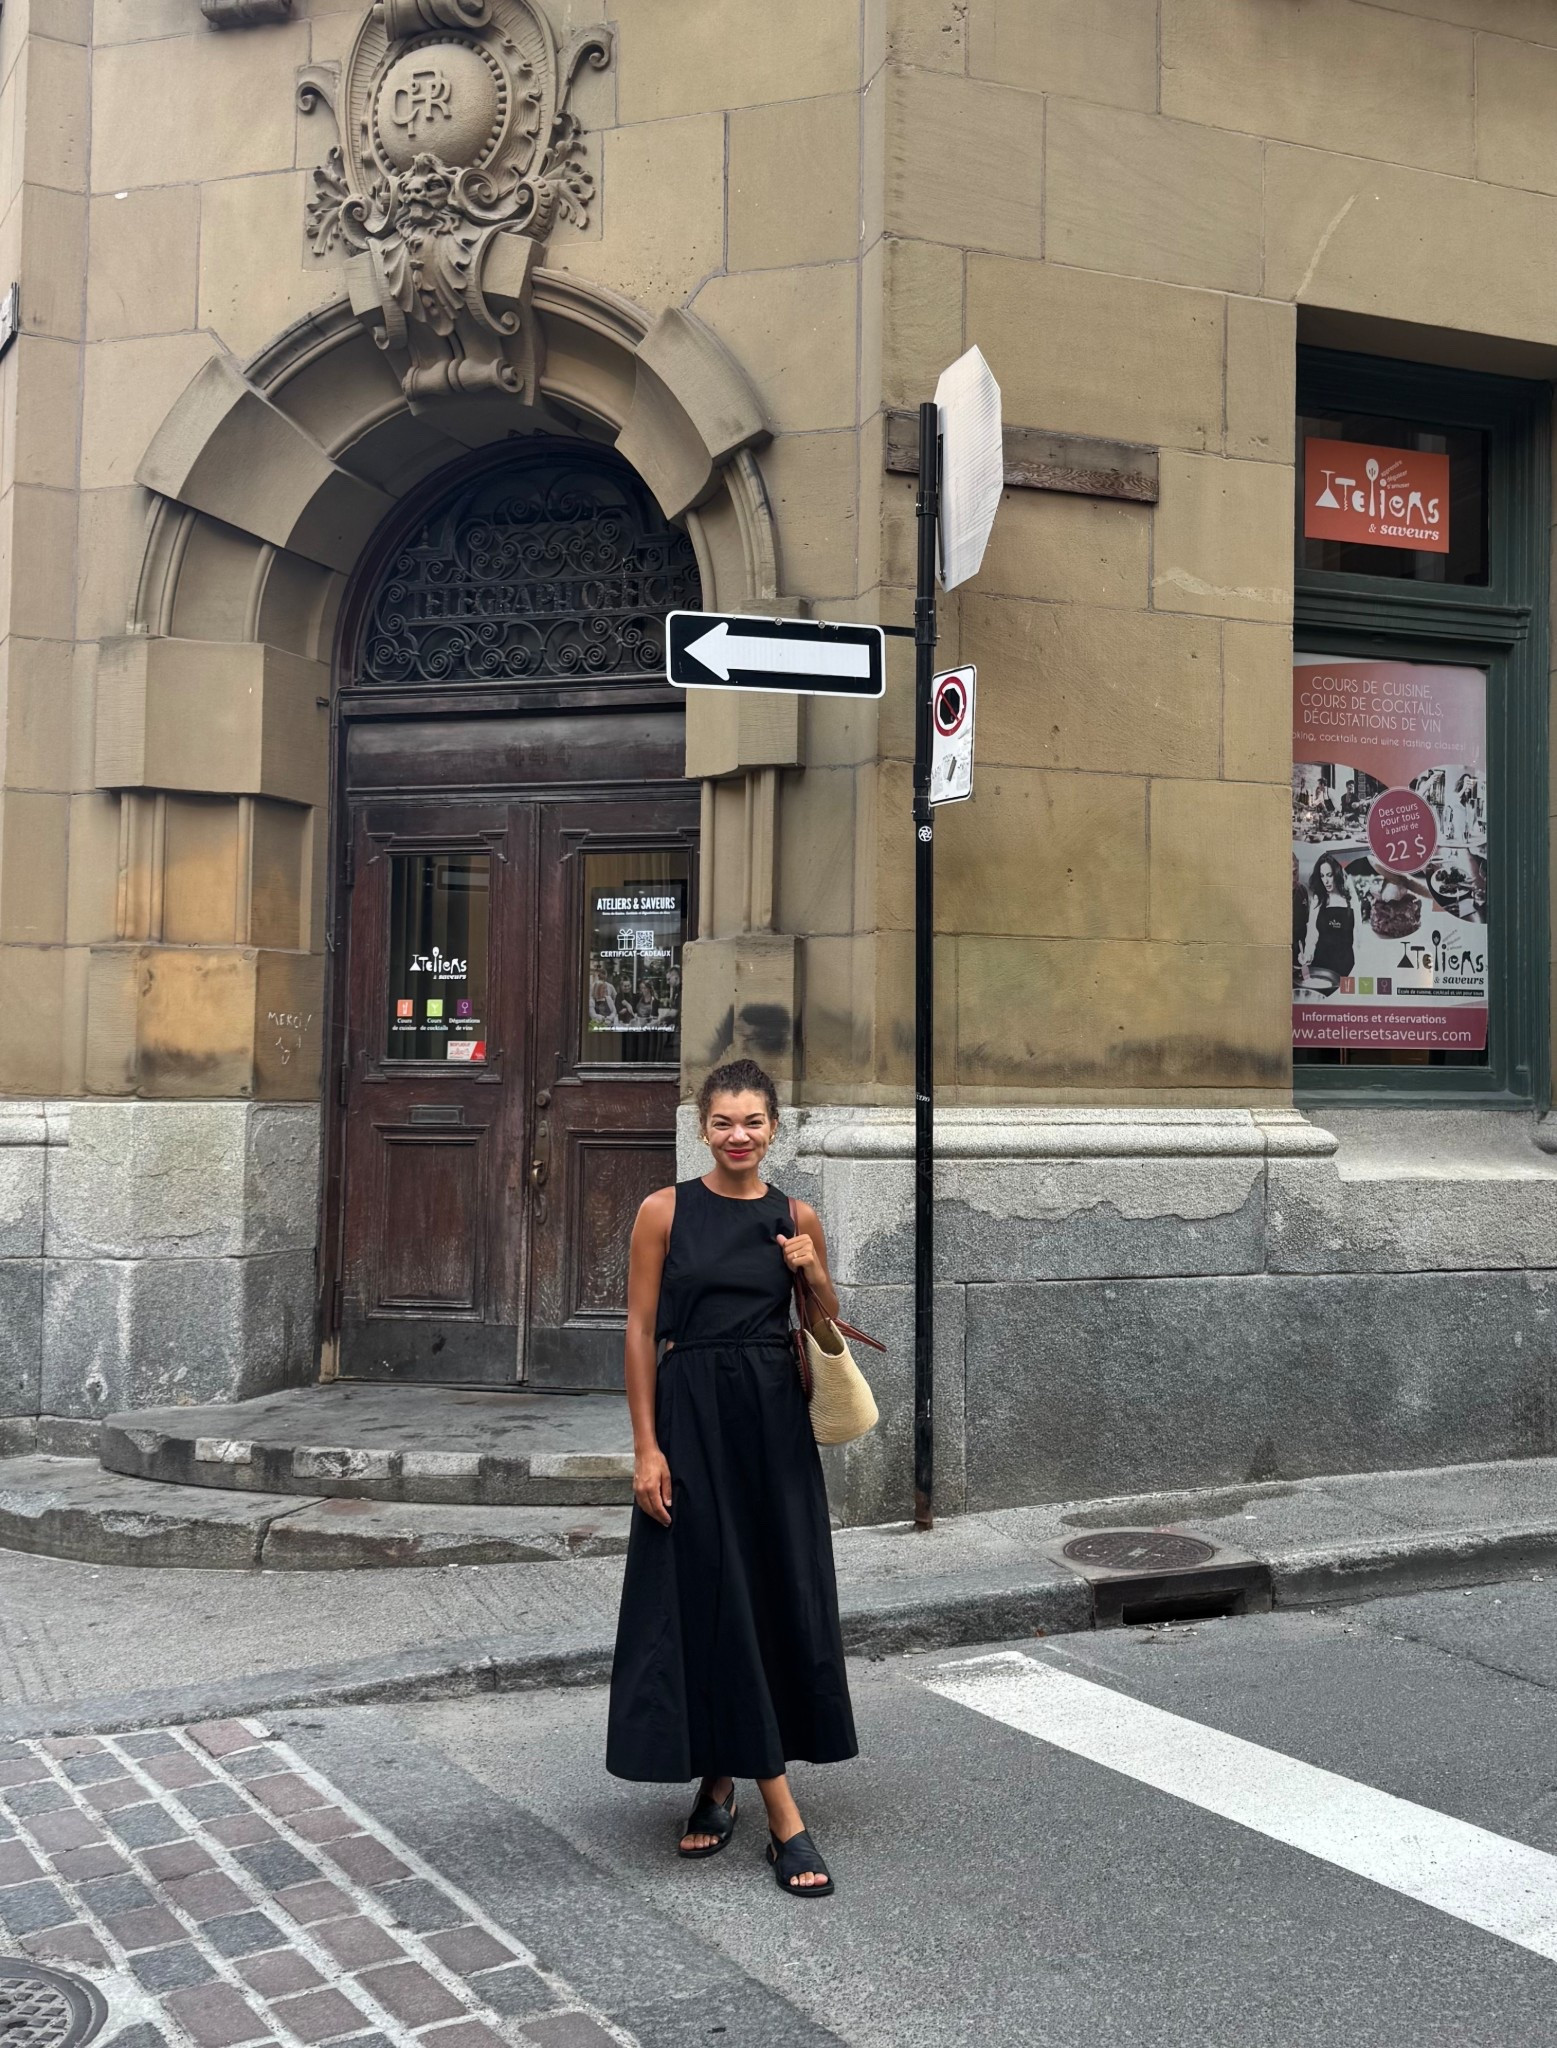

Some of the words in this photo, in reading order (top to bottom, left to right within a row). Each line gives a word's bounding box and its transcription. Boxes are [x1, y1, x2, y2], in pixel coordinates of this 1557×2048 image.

[1368, 523, 1377, 533] &
[1380, 524, 1440, 541] saveurs
[1312, 676, 1359, 693] COURS
[1362, 680, 1378, 695] DE
[1382, 681, 1434, 700] CUISINE,
[1300, 692, 1347, 709] COURS
[1351, 697, 1367, 711] DE
[1371, 698, 1445, 718] COCKTAILS,
[1303, 708, 1397, 730] DÉGUSTATIONS
[1401, 717, 1417, 732] DE
[1421, 719, 1442, 733] VIN
[1319, 733, 1358, 744] cocktails
[1360, 734, 1378, 745] and
[1380, 736, 1400, 747] wine
[1402, 739, 1432, 750] tasting
[1378, 808, 1394, 818] Des
[1395, 803, 1418, 814] cours
[1380, 816, 1400, 828] pour
[1401, 812, 1420, 822] tous
[1391, 824, 1409, 835] partir
[1409, 822, 1419, 830] de
[1385, 840, 1410, 862] 22
[1414, 834, 1426, 858] $
[596, 897, 632, 910] ATELIERS
[633, 897, 640, 910] &
[641, 896, 676, 910] SAVEURS
[600, 950, 671, 958] CERTIFICAT-CADEAUX
[1442, 976, 1485, 985] saveurs
[1302, 1012, 1369, 1023] Informations
[1371, 1014, 1382, 1023] et
[1384, 1012, 1447, 1025] réservations
